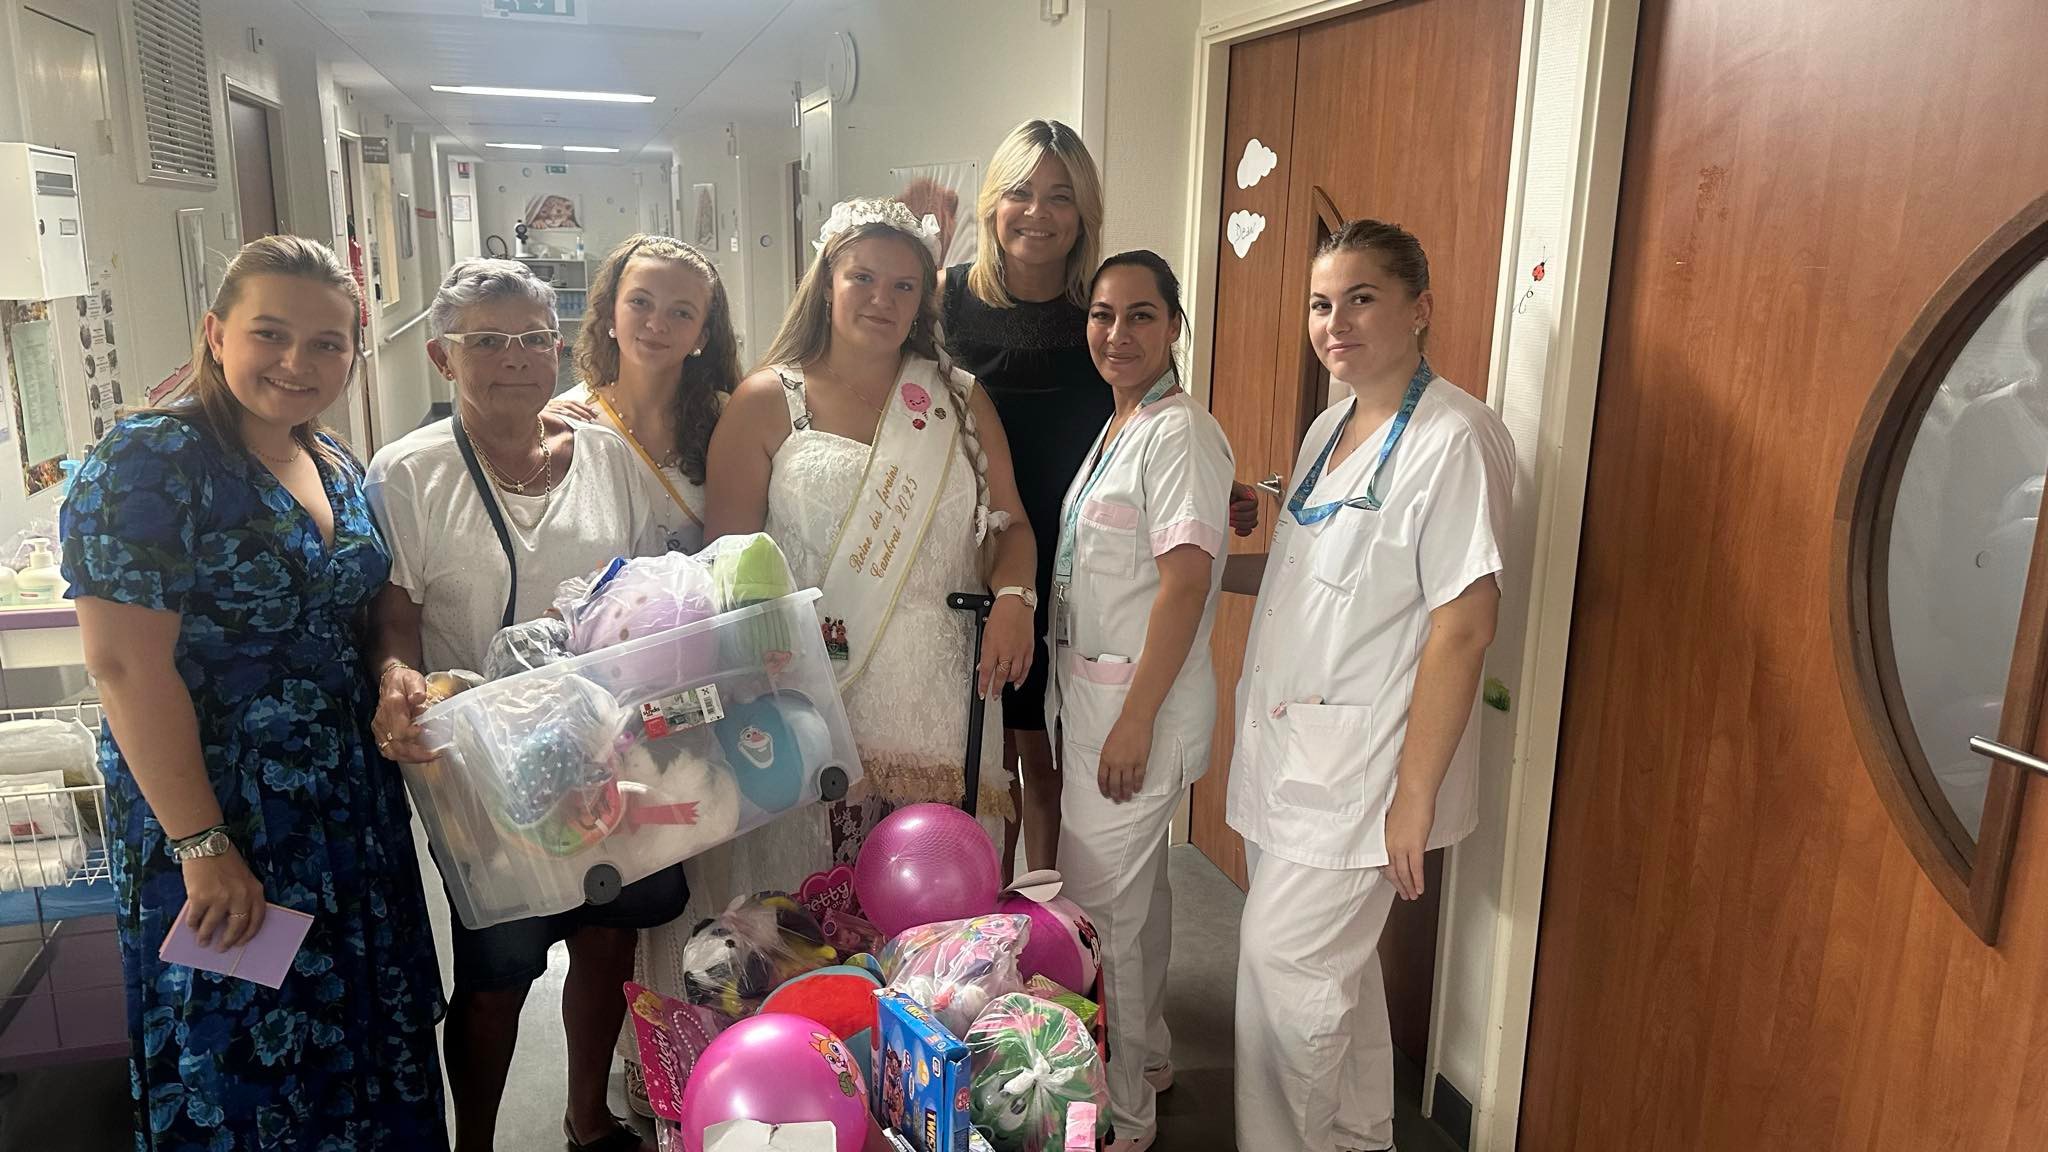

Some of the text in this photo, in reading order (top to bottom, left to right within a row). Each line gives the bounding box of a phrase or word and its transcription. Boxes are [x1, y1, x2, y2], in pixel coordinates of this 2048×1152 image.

[849, 464, 899, 574] Reine des forains
[870, 472, 918, 578] Cambrai 2025
[925, 1112, 937, 1152] TWIS
